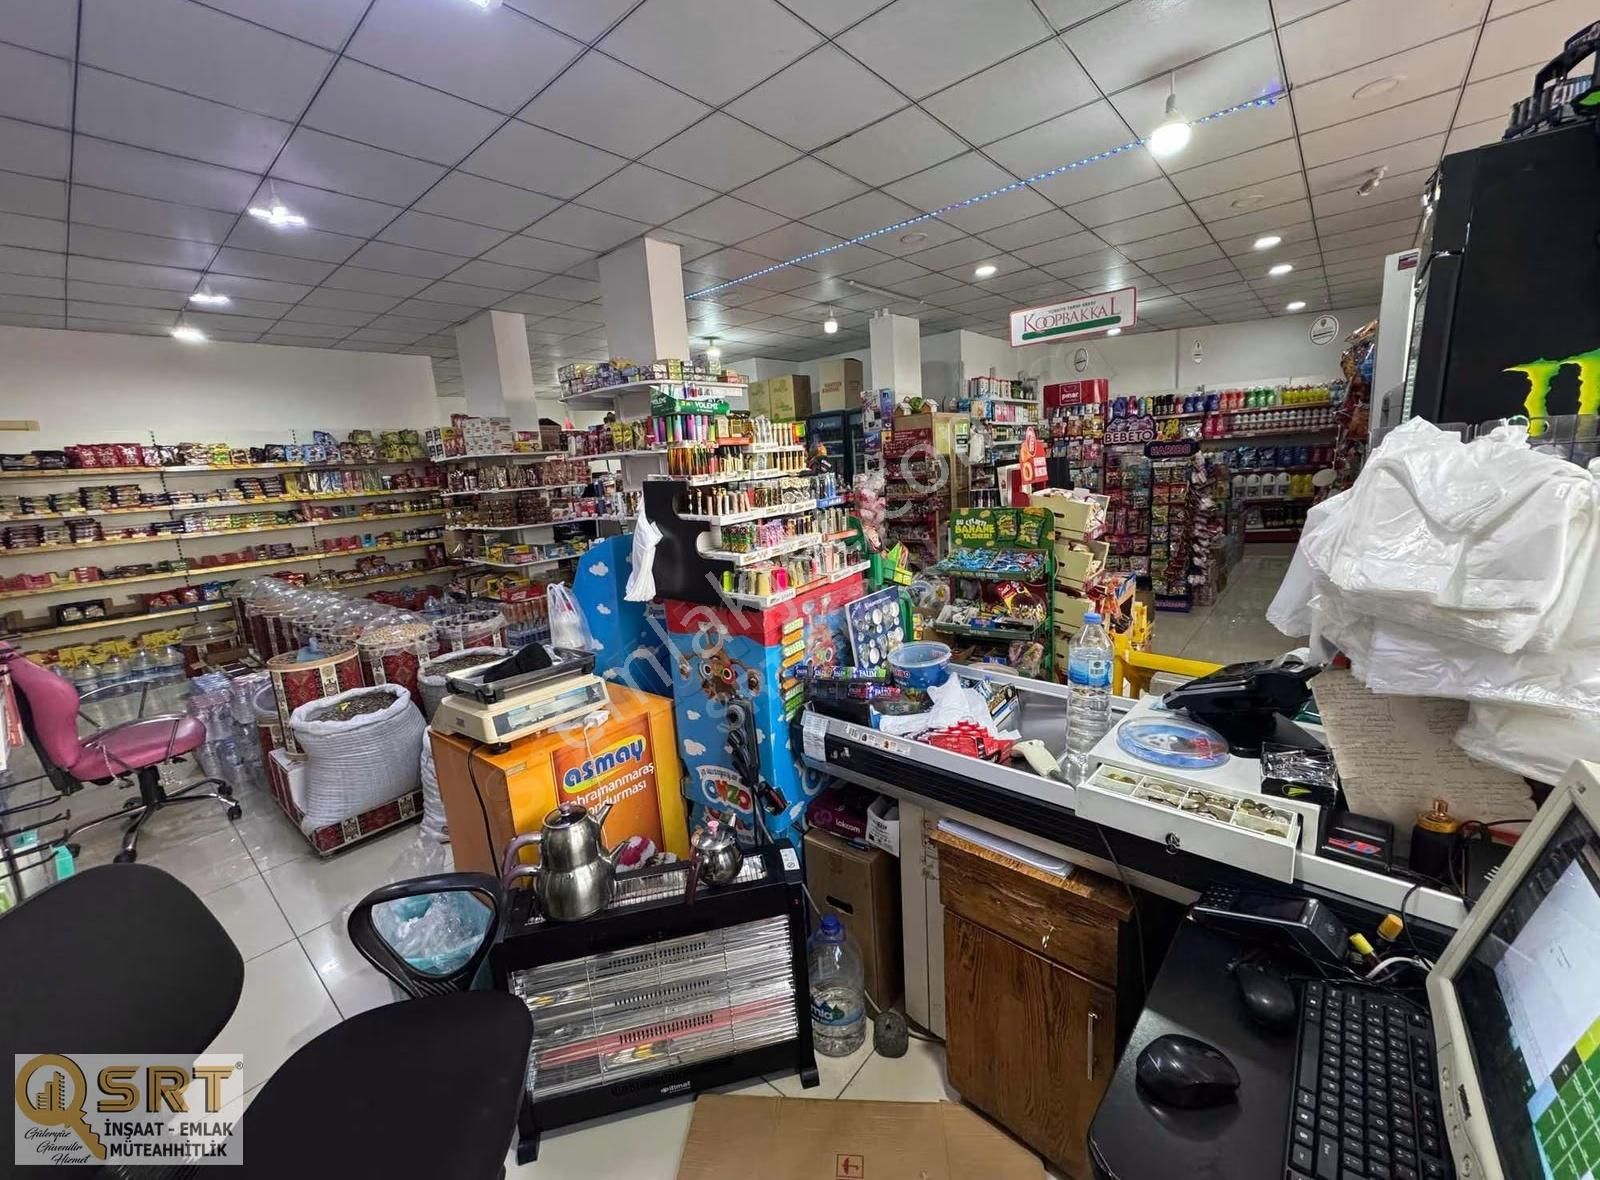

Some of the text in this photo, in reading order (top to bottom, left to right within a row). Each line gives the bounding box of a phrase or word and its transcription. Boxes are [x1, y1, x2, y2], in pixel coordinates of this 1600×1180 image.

[1023, 297, 1121, 332] KOOPBAKKAL
[1104, 430, 1154, 444] BEBETO
[564, 738, 643, 788] asmay
